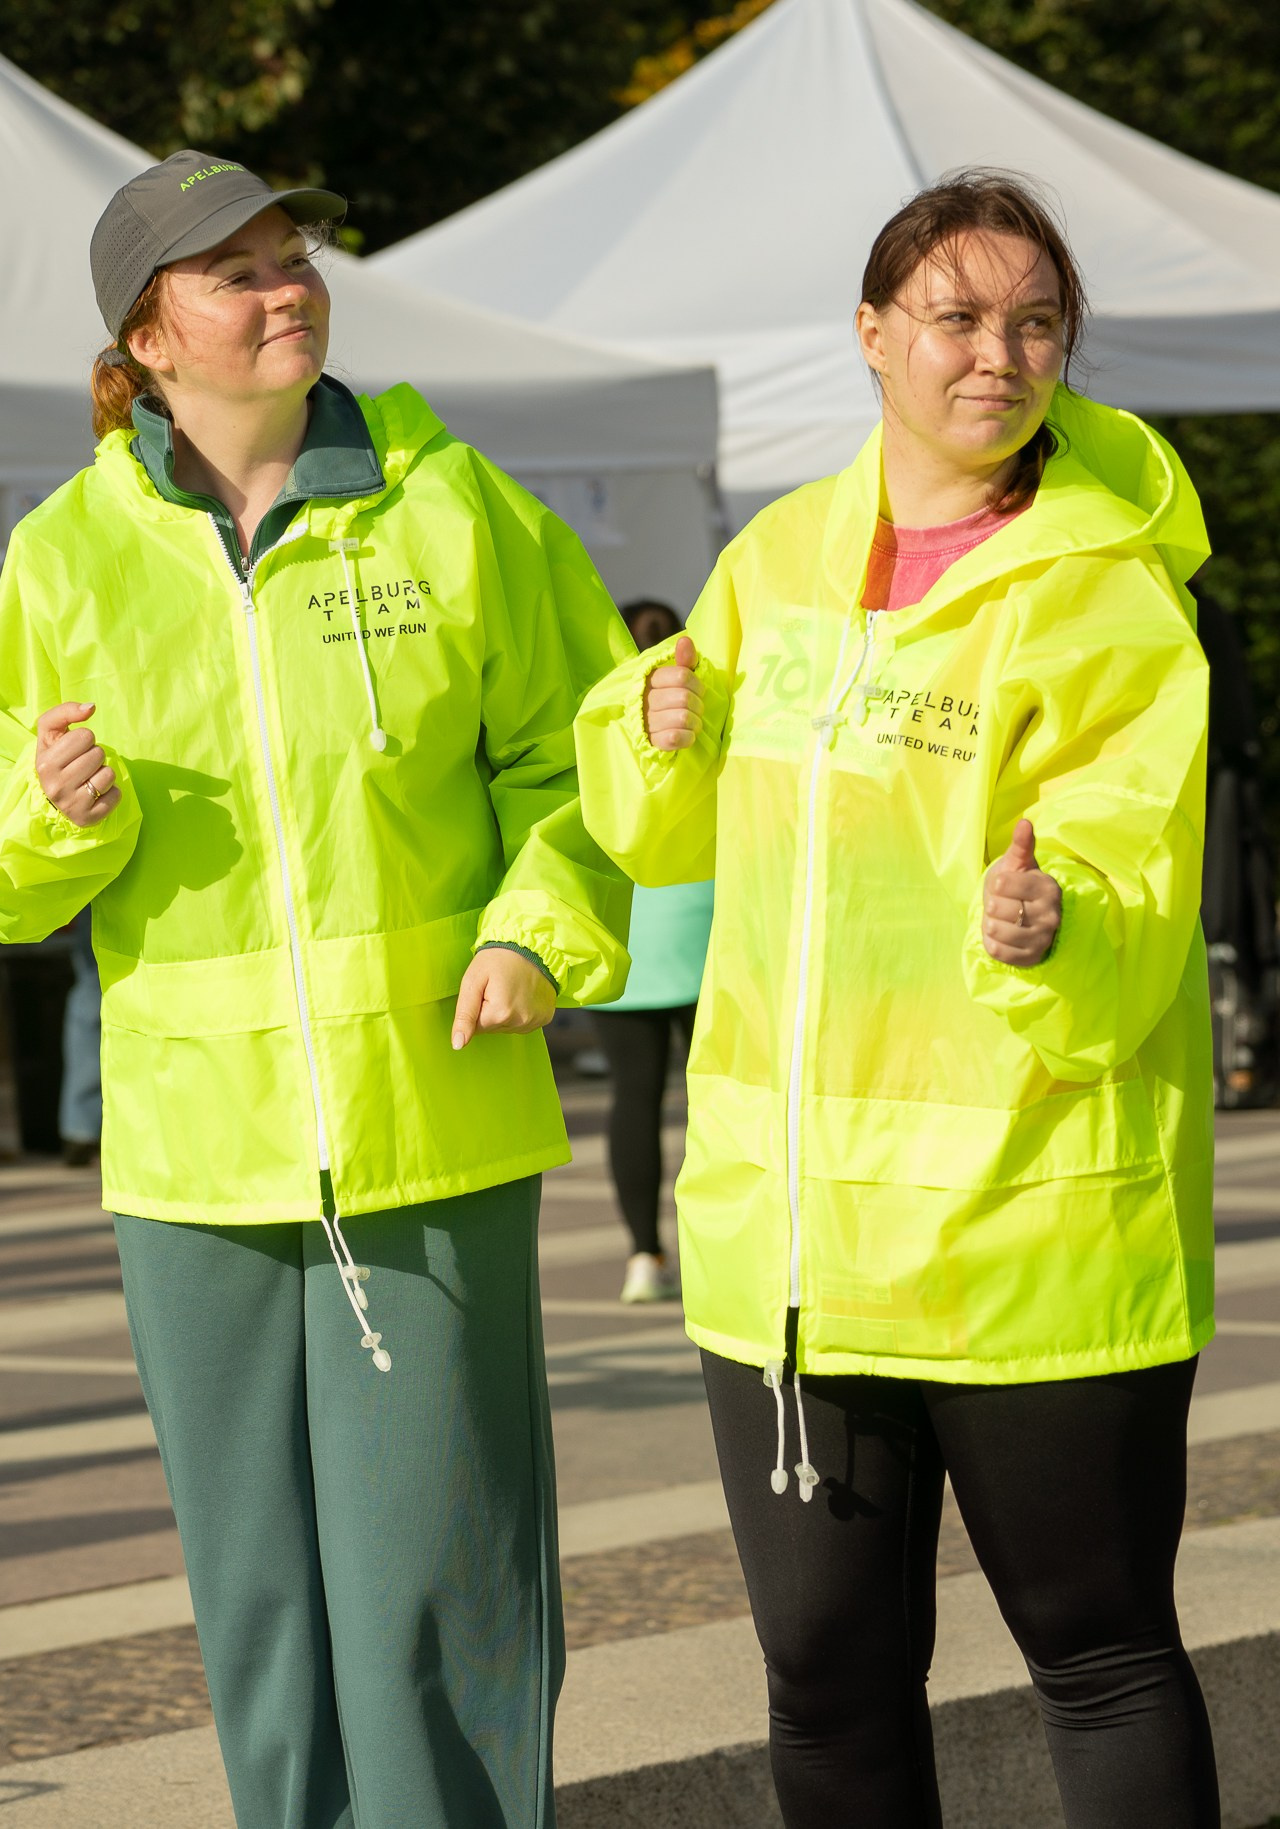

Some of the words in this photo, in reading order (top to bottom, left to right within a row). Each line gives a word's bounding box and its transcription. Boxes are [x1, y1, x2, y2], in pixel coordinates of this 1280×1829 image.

[308, 580, 431, 609] APELBURG
[323, 598, 421, 621] TEAM
[374, 627, 396, 638] WE
[399, 623, 427, 635] RUN
[883, 690, 980, 720] APELBU
[877, 733, 924, 750] UNITED
[927, 742, 950, 757] WE
[952, 748, 976, 762] RU
